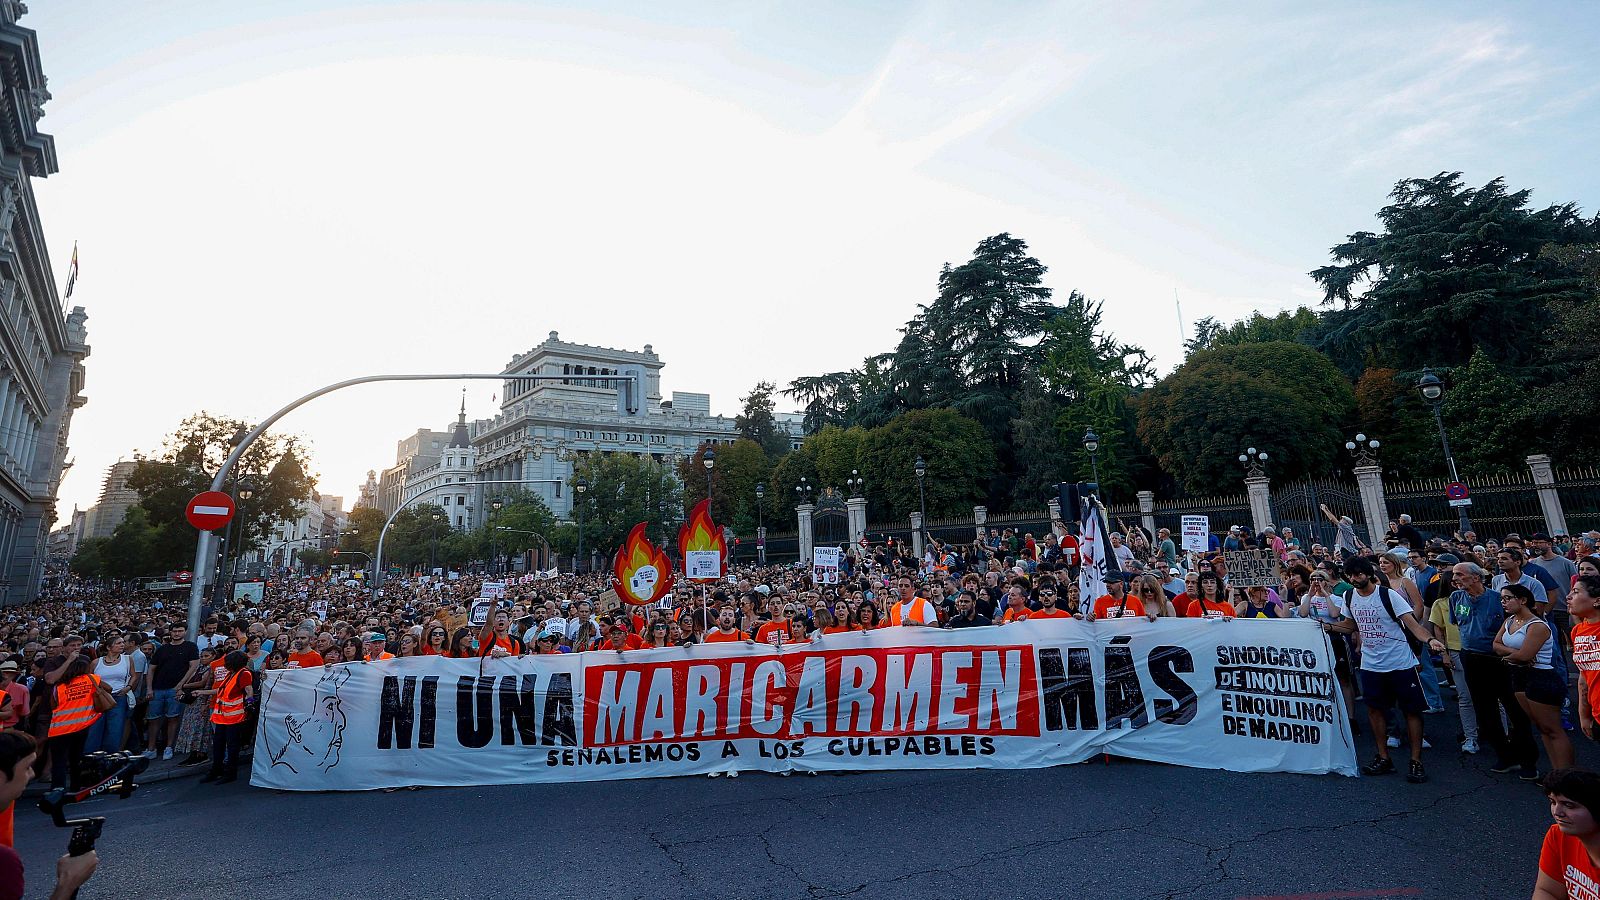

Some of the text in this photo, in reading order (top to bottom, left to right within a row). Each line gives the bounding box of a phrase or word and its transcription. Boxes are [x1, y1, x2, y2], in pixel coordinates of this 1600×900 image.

[1224, 549, 1274, 561] EL PLAN DE
[1225, 559, 1276, 572] VIVIENDA NO
[1228, 568, 1273, 579] DEBE SER
[1216, 645, 1316, 670] SINDICATO
[1220, 670, 1242, 688] DE
[377, 635, 1199, 750] NI UNA MARICARMEN MÁS
[1221, 693, 1333, 725] E INQUILINOS
[1222, 714, 1321, 745] DE MADRID
[721, 740, 740, 758] A
[759, 739, 805, 760] LOS
[827, 736, 997, 756] CULPABLES
[89, 776, 119, 796] RONIN
